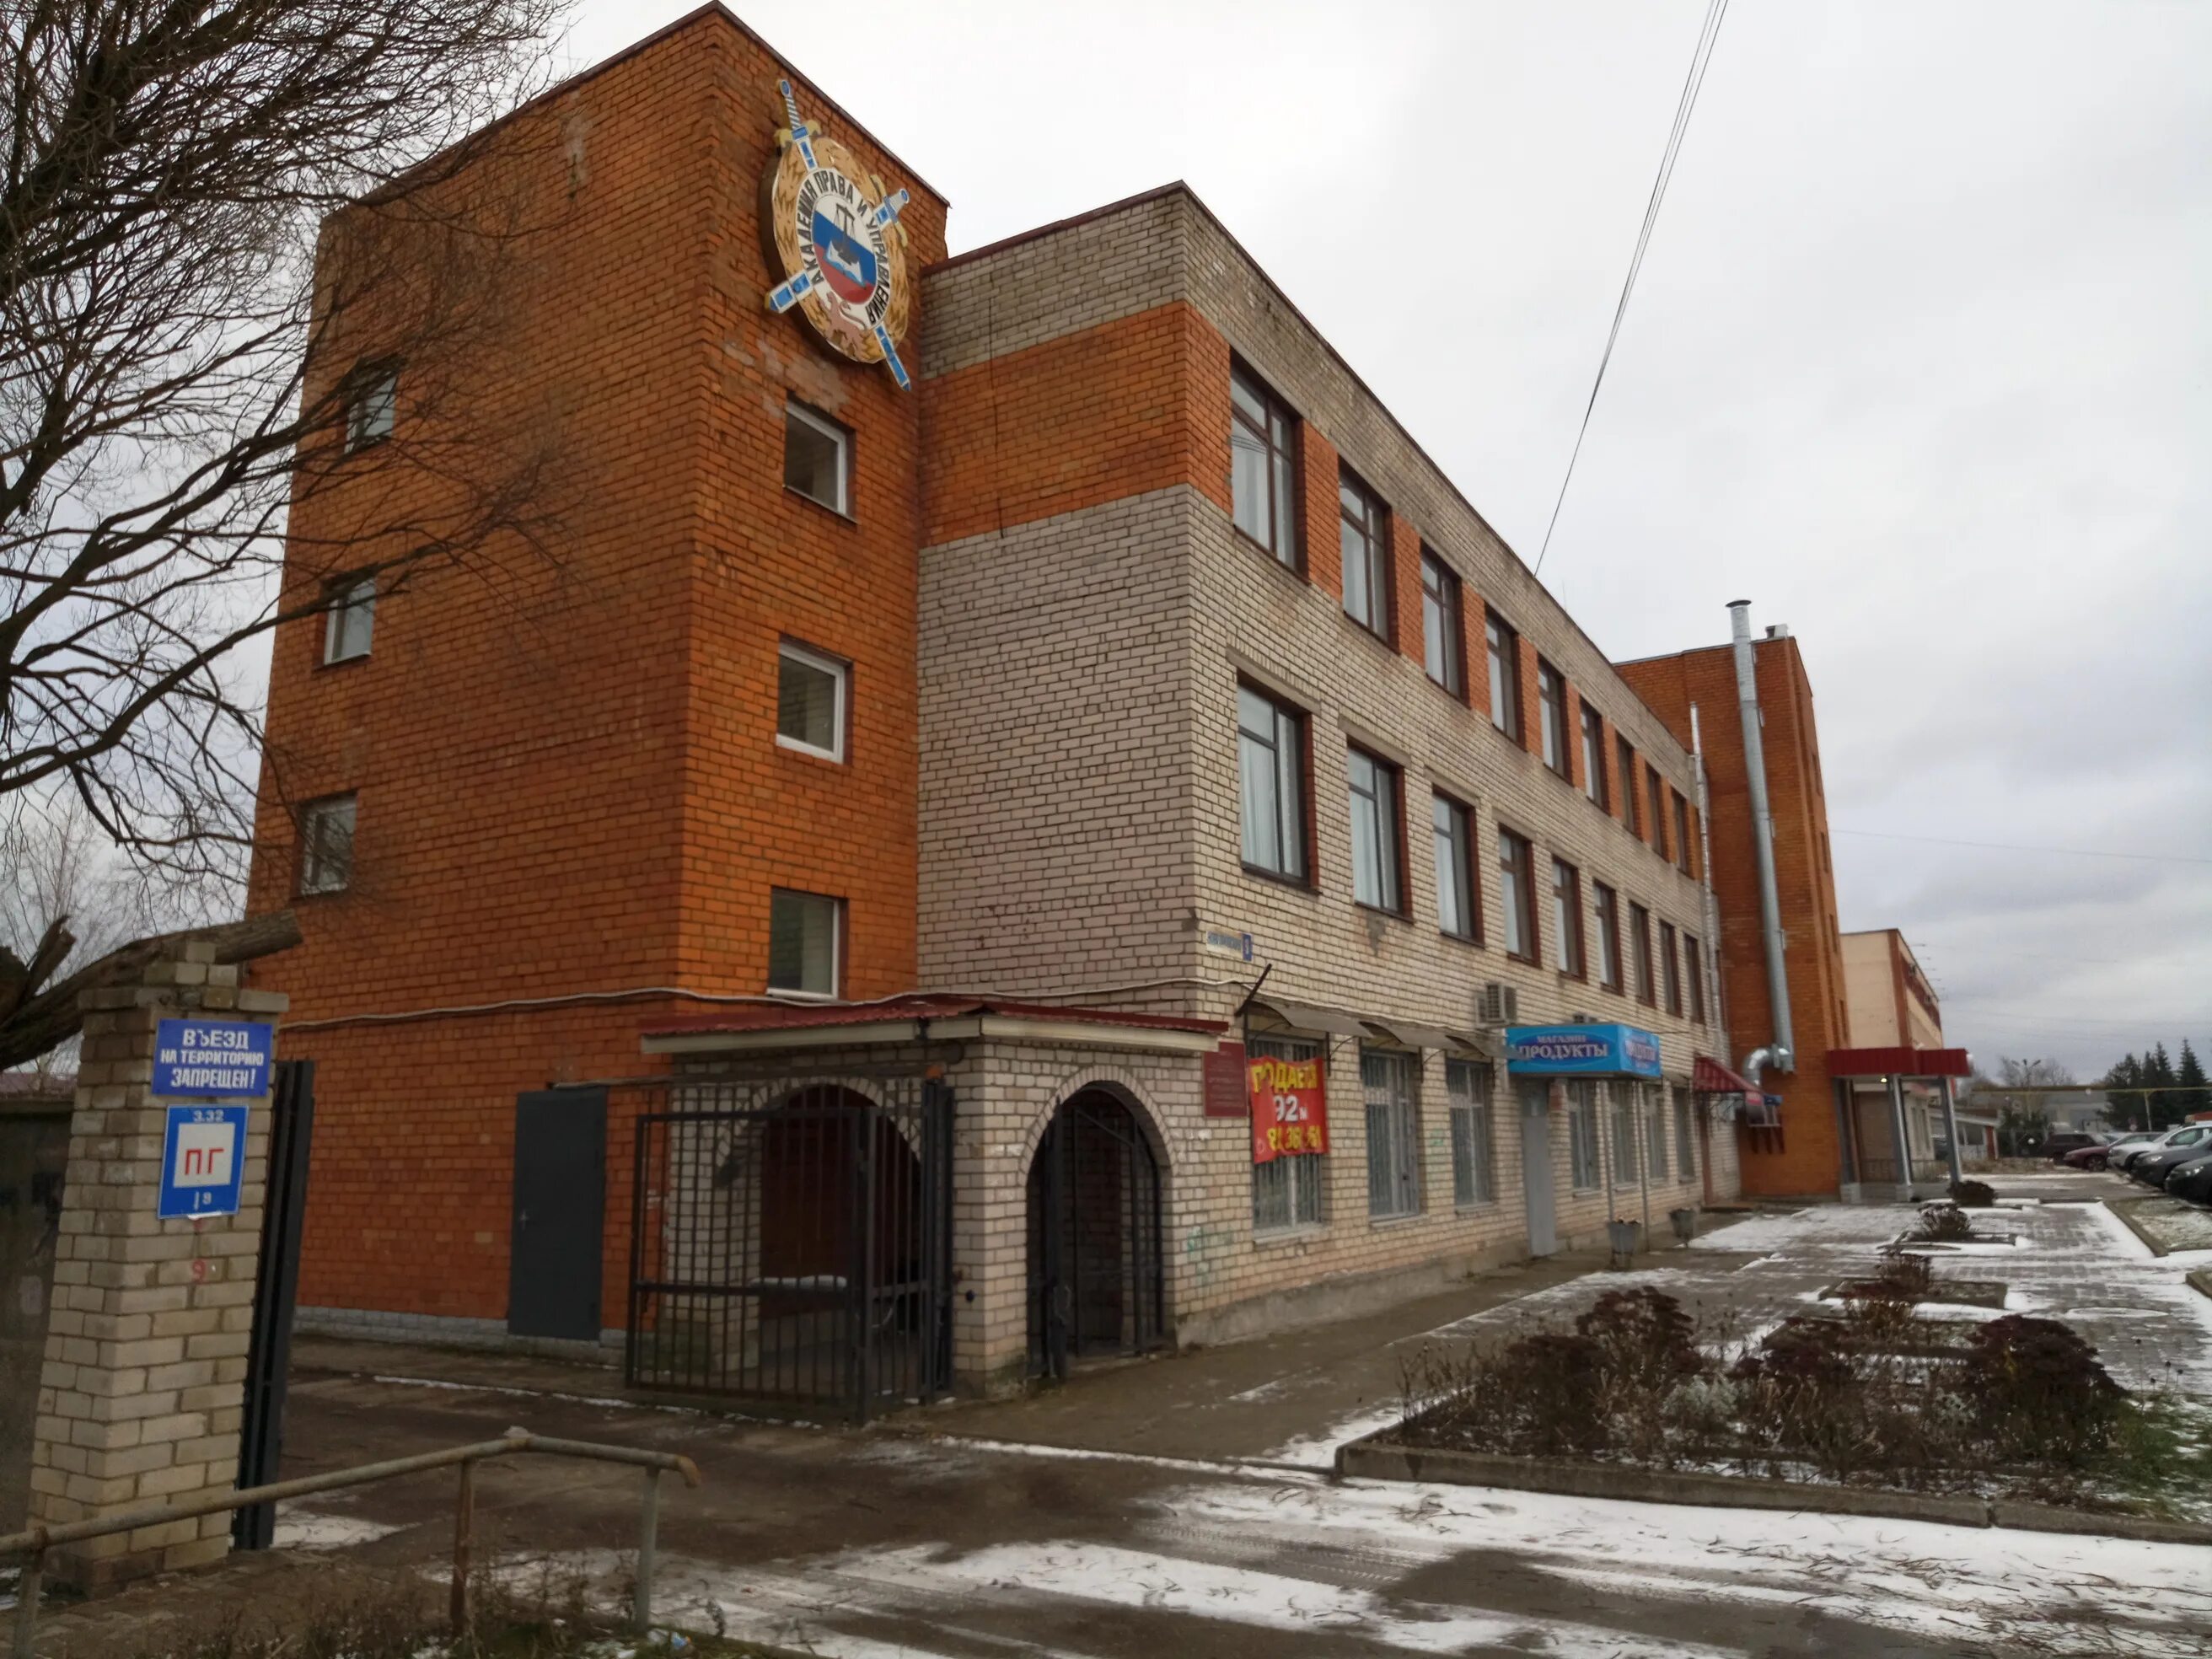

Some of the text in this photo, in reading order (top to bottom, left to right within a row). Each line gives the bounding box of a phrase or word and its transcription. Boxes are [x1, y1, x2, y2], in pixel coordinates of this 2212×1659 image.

[797, 170, 890, 325] АКАДЕМИЯ ПРАВА И УПРАВЛЕНИЯ
[182, 1028, 249, 1050] ВЪЕЗД
[160, 1049, 264, 1066] НА ТЕРРИТОРИЮ
[1519, 1044, 1608, 1060] ПРОДУКТЫ
[170, 1067, 255, 1089] ЗАПРЕЩЕН!
